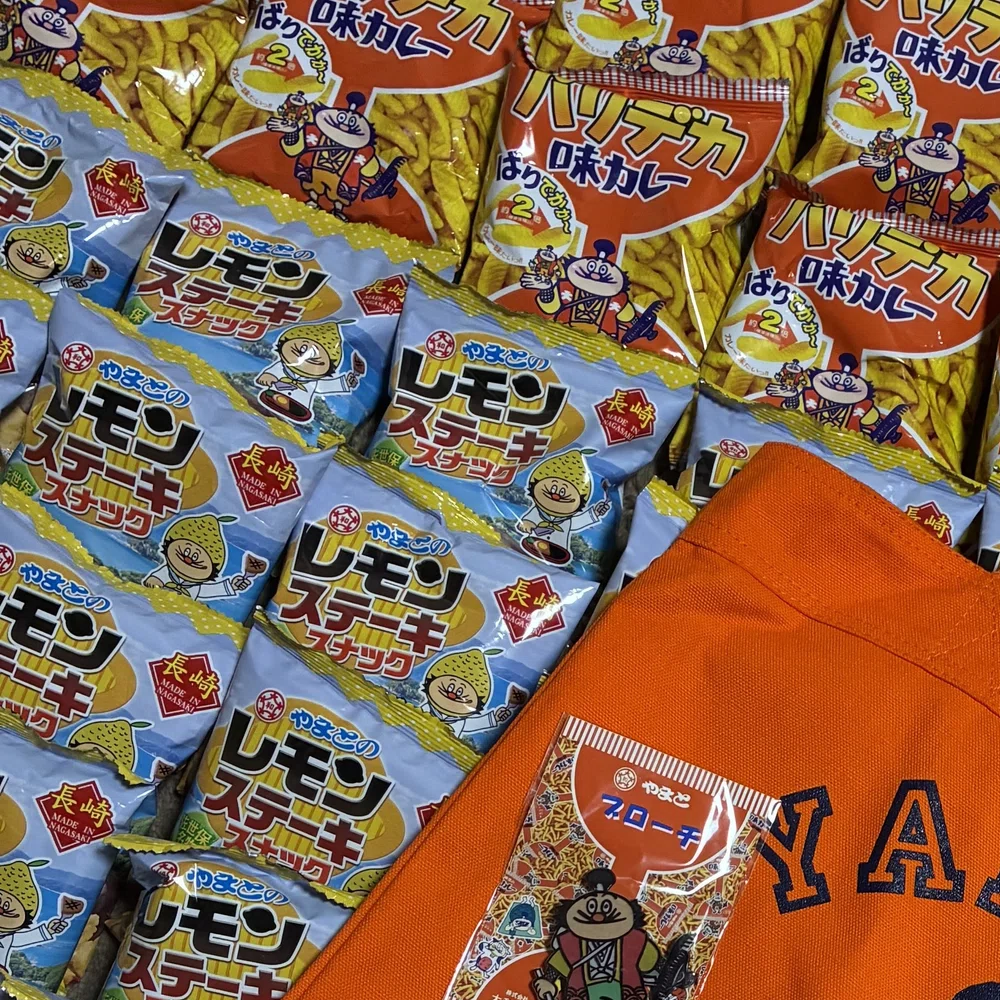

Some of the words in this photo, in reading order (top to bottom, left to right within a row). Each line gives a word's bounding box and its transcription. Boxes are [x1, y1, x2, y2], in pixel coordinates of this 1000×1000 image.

[549, 139, 692, 202] 味カレー
[152, 221, 328, 300] レモン
[227, 231, 314, 261] やまとの
[137, 265, 312, 328] ステーキ
[796, 255, 938, 325] 味カレー
[156, 302, 271, 341] スナック
[461, 340, 551, 372] やまとの
[99, 360, 190, 407] やまとの
[400, 346, 569, 430] レモン
[46, 387, 203, 467] レモン
[388, 398, 550, 465] ステーキ
[606, 390, 655, 429] 長崎
[23, 421, 183, 517] ステーキ
[241, 472, 267, 488] MADE
[242, 445, 298, 490] 長崎
[408, 437, 520, 487] スナック
[41, 478, 155, 538] スナック
[237, 480, 278, 505] NAGASAKI
[366, 521, 451, 556] やまとの
[20, 563, 111, 612] やまとの
[294, 522, 471, 612] レモン
[280, 578, 450, 656] ステーキ
[163, 653, 219, 699] 長崎
[306, 630, 416, 680] スナック
[157, 687, 195, 714] NAGASAKI
[160, 679, 186, 697] MADE
[290, 708, 380, 758] やまとの
[219, 708, 392, 817] レモン
[51, 783, 111, 828] 長崎
[202, 767, 367, 868] ステーキ
[641, 780, 691, 809] やまと
[48, 820, 91, 844] NAGASAKI
[51, 812, 79, 829] MADE
[601, 793, 700, 850] ブローチ
[187, 868, 289, 906] やまとの
[131, 887, 310, 969] レモン
